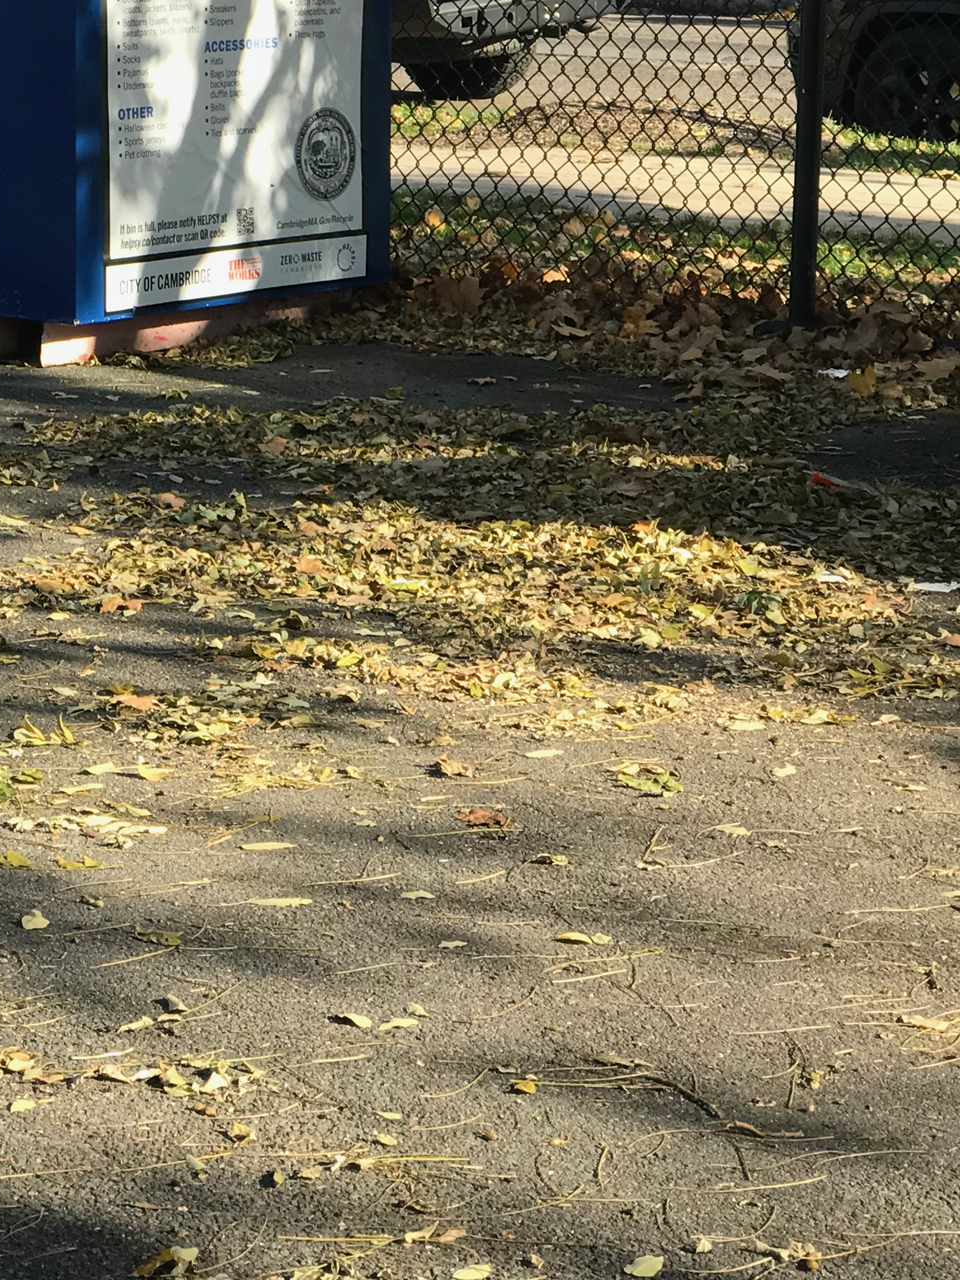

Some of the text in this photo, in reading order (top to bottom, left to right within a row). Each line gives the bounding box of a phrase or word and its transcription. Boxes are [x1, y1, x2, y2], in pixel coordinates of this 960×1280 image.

[209, 4, 236, 14] Sneakers
[209, 17, 234, 27] Slippers
[204, 37, 278, 53] ACCESSORIES
[122, 55, 141, 64] Socks
[210, 57, 223, 65] Hats
[210, 69, 224, 79] Bags
[210, 103, 225, 112] Belts
[118, 106, 154, 120] OTHER
[210, 116, 229, 125] Gloves
[124, 138, 144, 148] Sports
[124, 151, 135, 159] Pet
[127, 224, 136, 234] bin
[158, 219, 178, 234] please
[179, 217, 196, 228] notify
[197, 214, 220, 226] HELPSY
[221, 213, 227, 223] at
[185, 232, 198, 242] scan
[200, 229, 208, 240] QR
[280, 251, 322, 265] ZERO WASTE
[120, 268, 211, 295] CITY OF CAMBRIDGE
